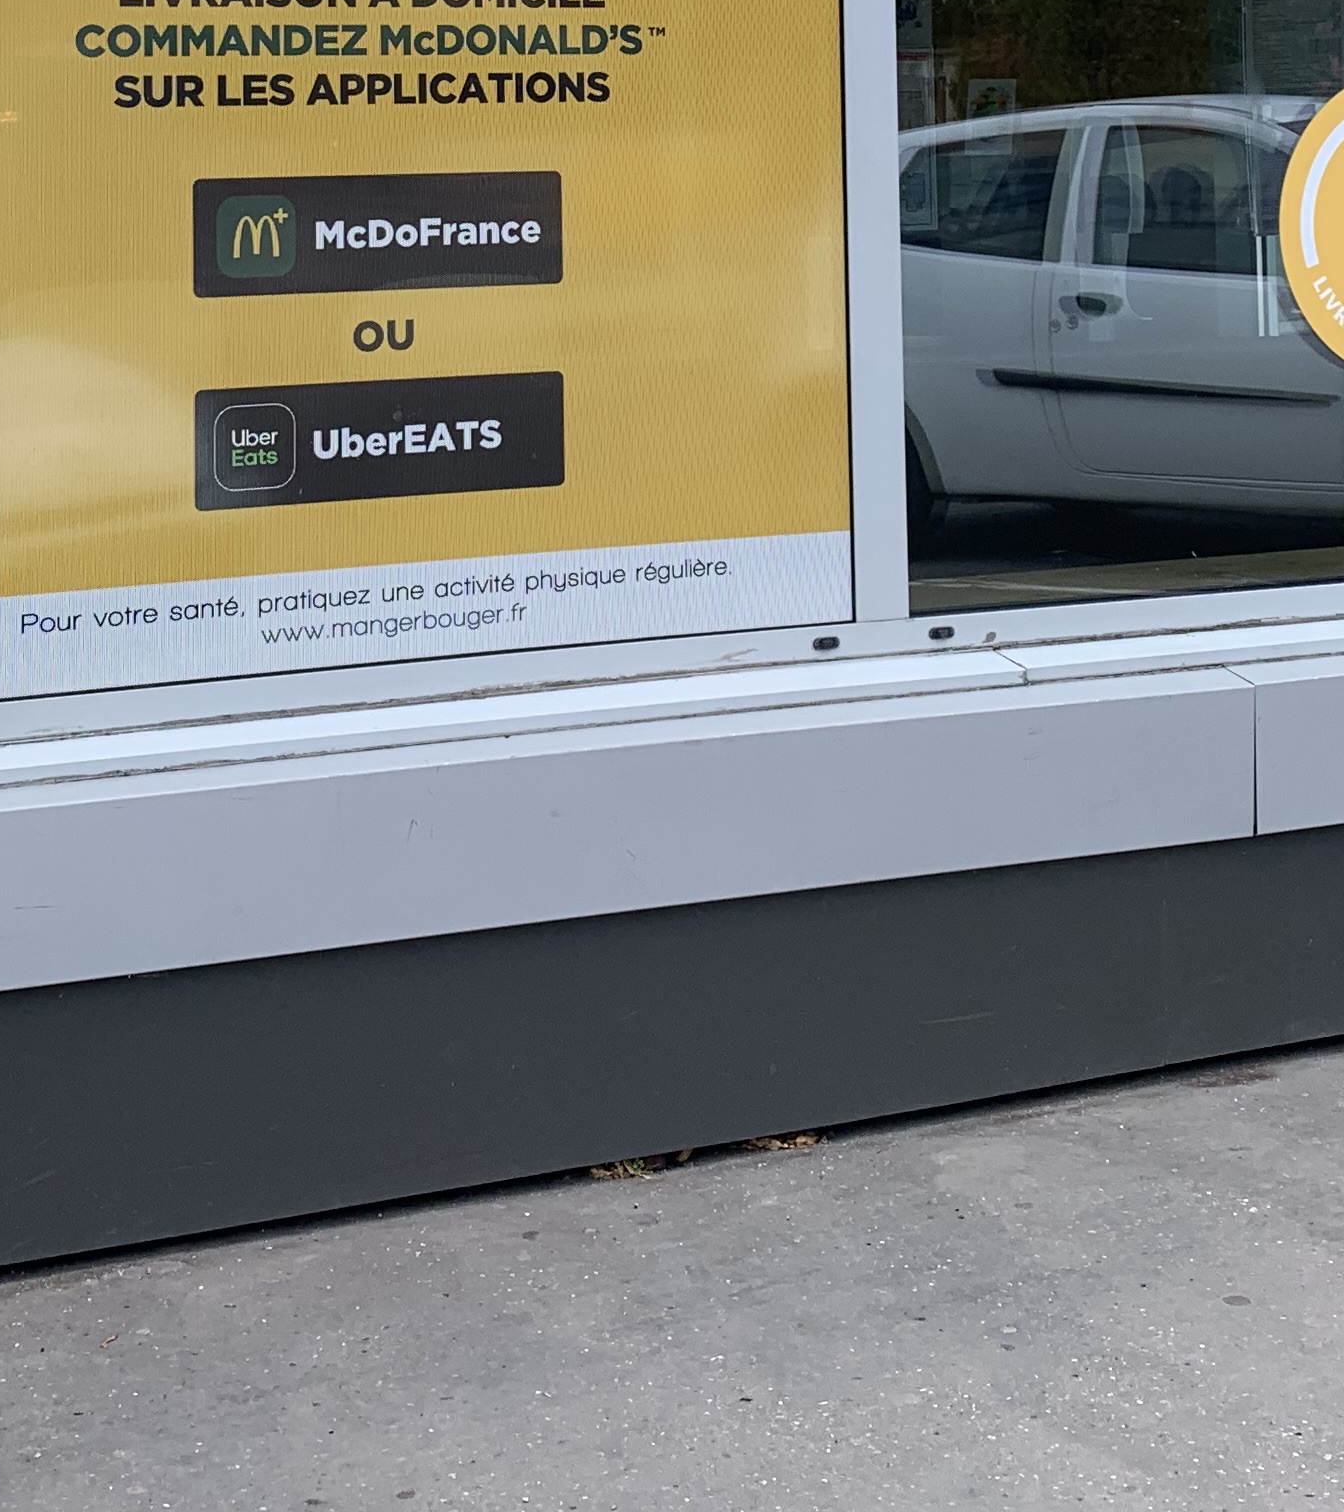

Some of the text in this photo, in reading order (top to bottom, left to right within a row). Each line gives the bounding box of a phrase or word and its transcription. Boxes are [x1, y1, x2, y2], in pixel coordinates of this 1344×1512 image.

[73, 24, 368, 57] COMMANDEZ
[113, 71, 612, 108] SUR LES APPLICATIONS
[314, 217, 542, 250] McDoFrance
[352, 318, 415, 352] OU
[231, 428, 279, 447] Uber
[312, 418, 503, 460] UberEATS
[231, 448, 279, 467] Eats
[20, 557, 733, 634] Pour votre santé, pratiquez une activité physique régulière.
[260, 602, 528, 644] www.mangerbouger.fr
